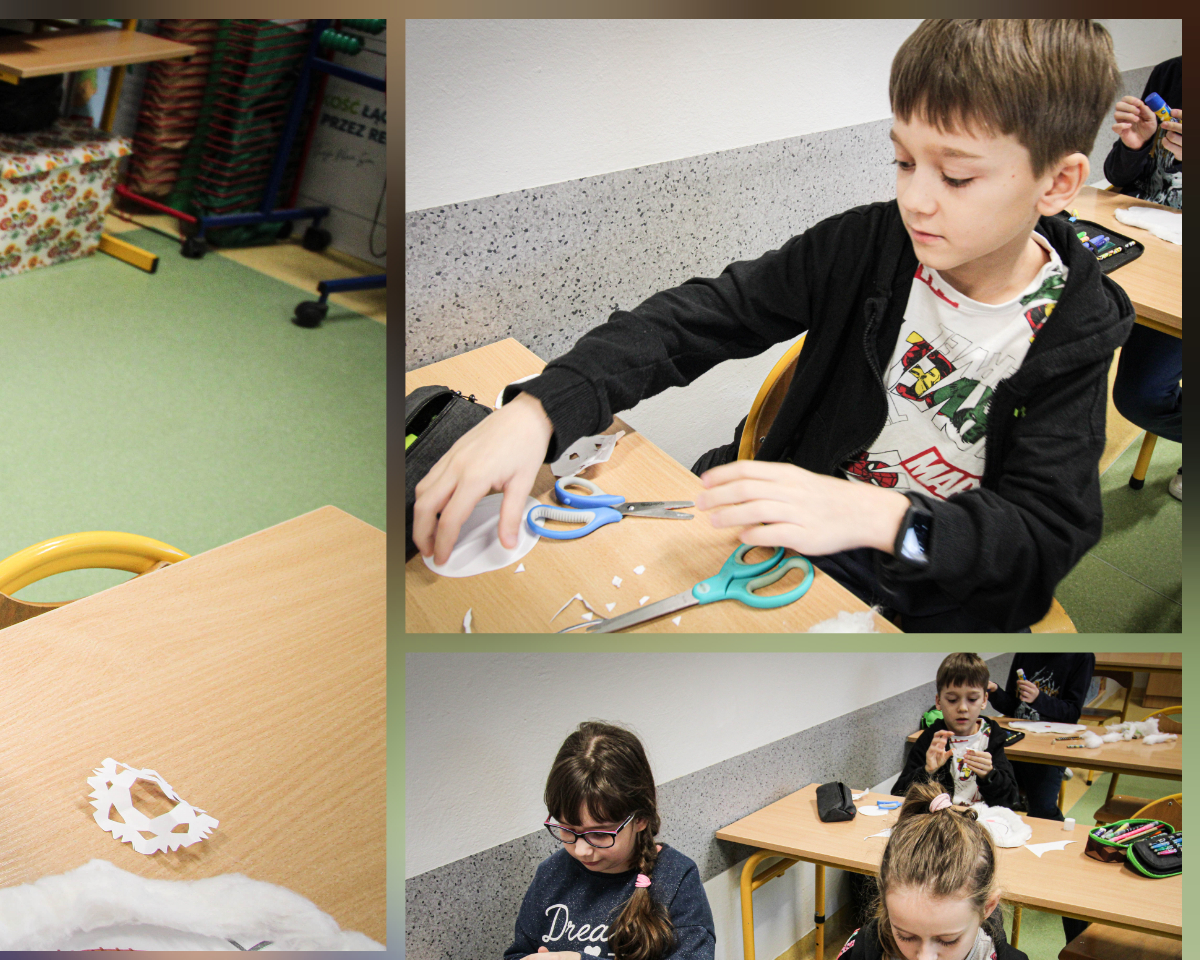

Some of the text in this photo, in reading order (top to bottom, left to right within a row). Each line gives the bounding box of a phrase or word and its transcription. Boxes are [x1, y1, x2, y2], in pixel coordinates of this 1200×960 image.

[320, 113, 367, 138] PRZEZ
[904, 449, 980, 498] MAR
[541, 903, 611, 943] Drea
